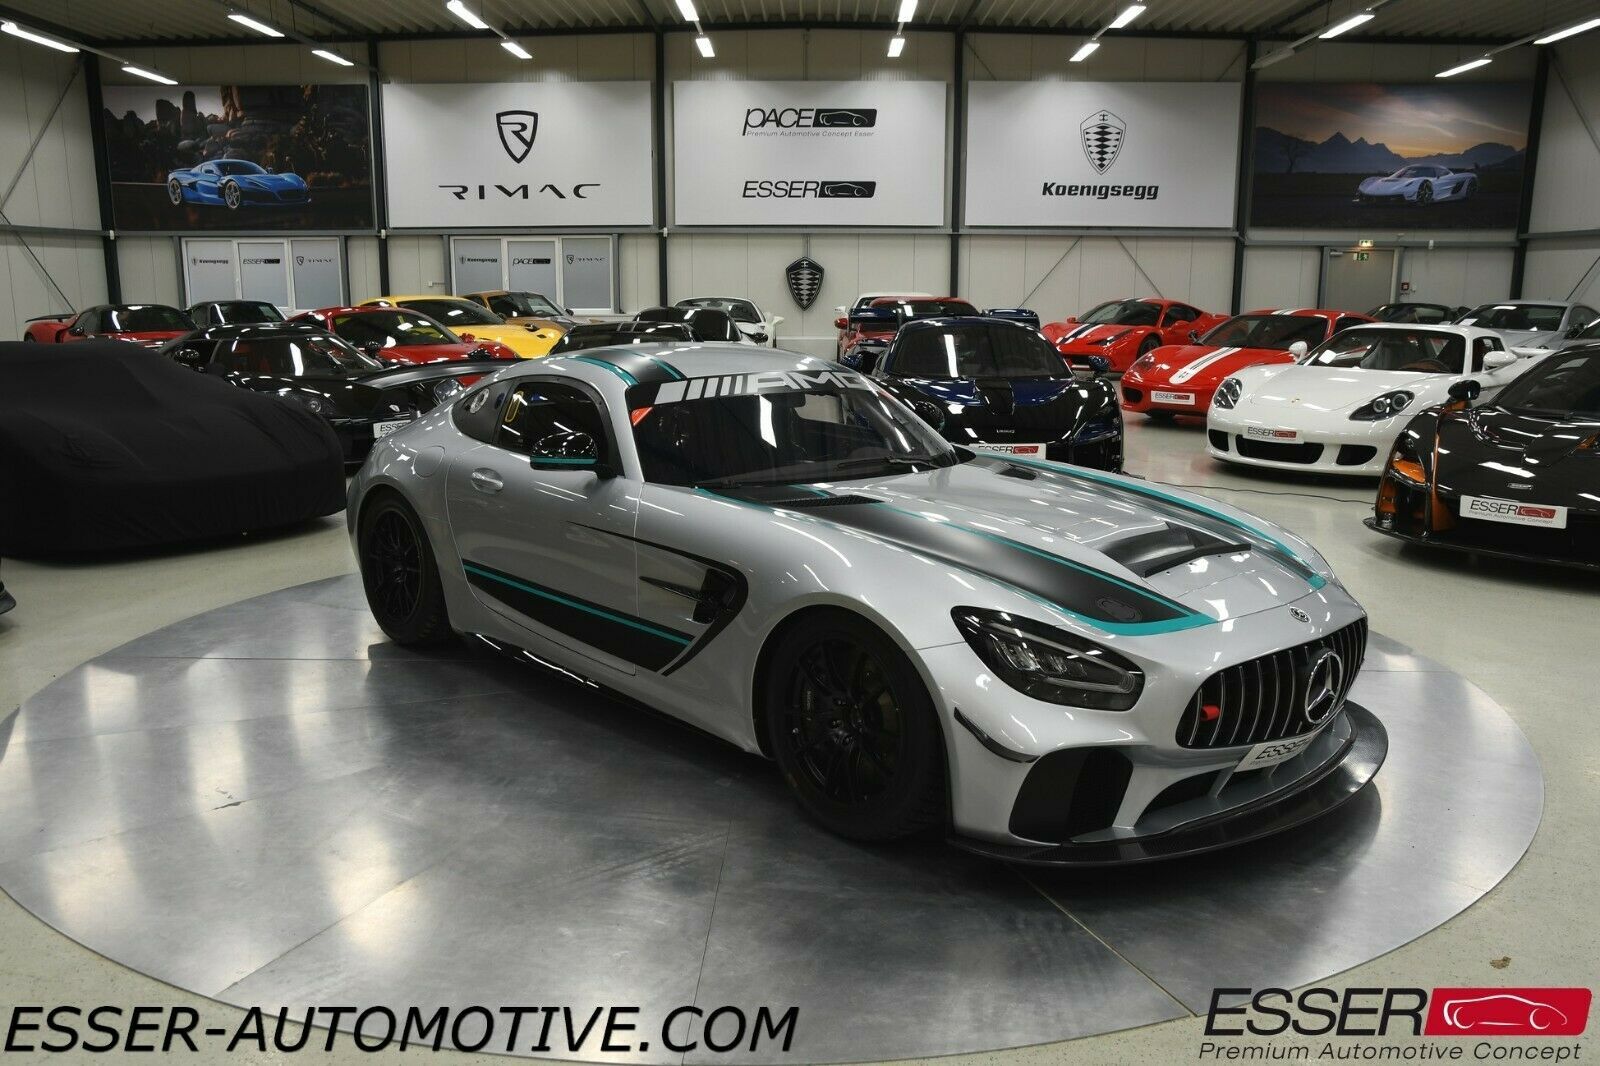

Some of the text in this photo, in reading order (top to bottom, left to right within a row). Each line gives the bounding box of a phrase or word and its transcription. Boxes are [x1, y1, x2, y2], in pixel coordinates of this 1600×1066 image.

[780, 130, 820, 138] Automotive
[822, 130, 852, 138] Concept
[438, 183, 601, 200] RIMAC
[742, 180, 820, 198] ESSER
[1042, 182, 1159, 200] Koenigsegg
[1247, 426, 1275, 437] ESSER
[1470, 499, 1519, 516] ESSER
